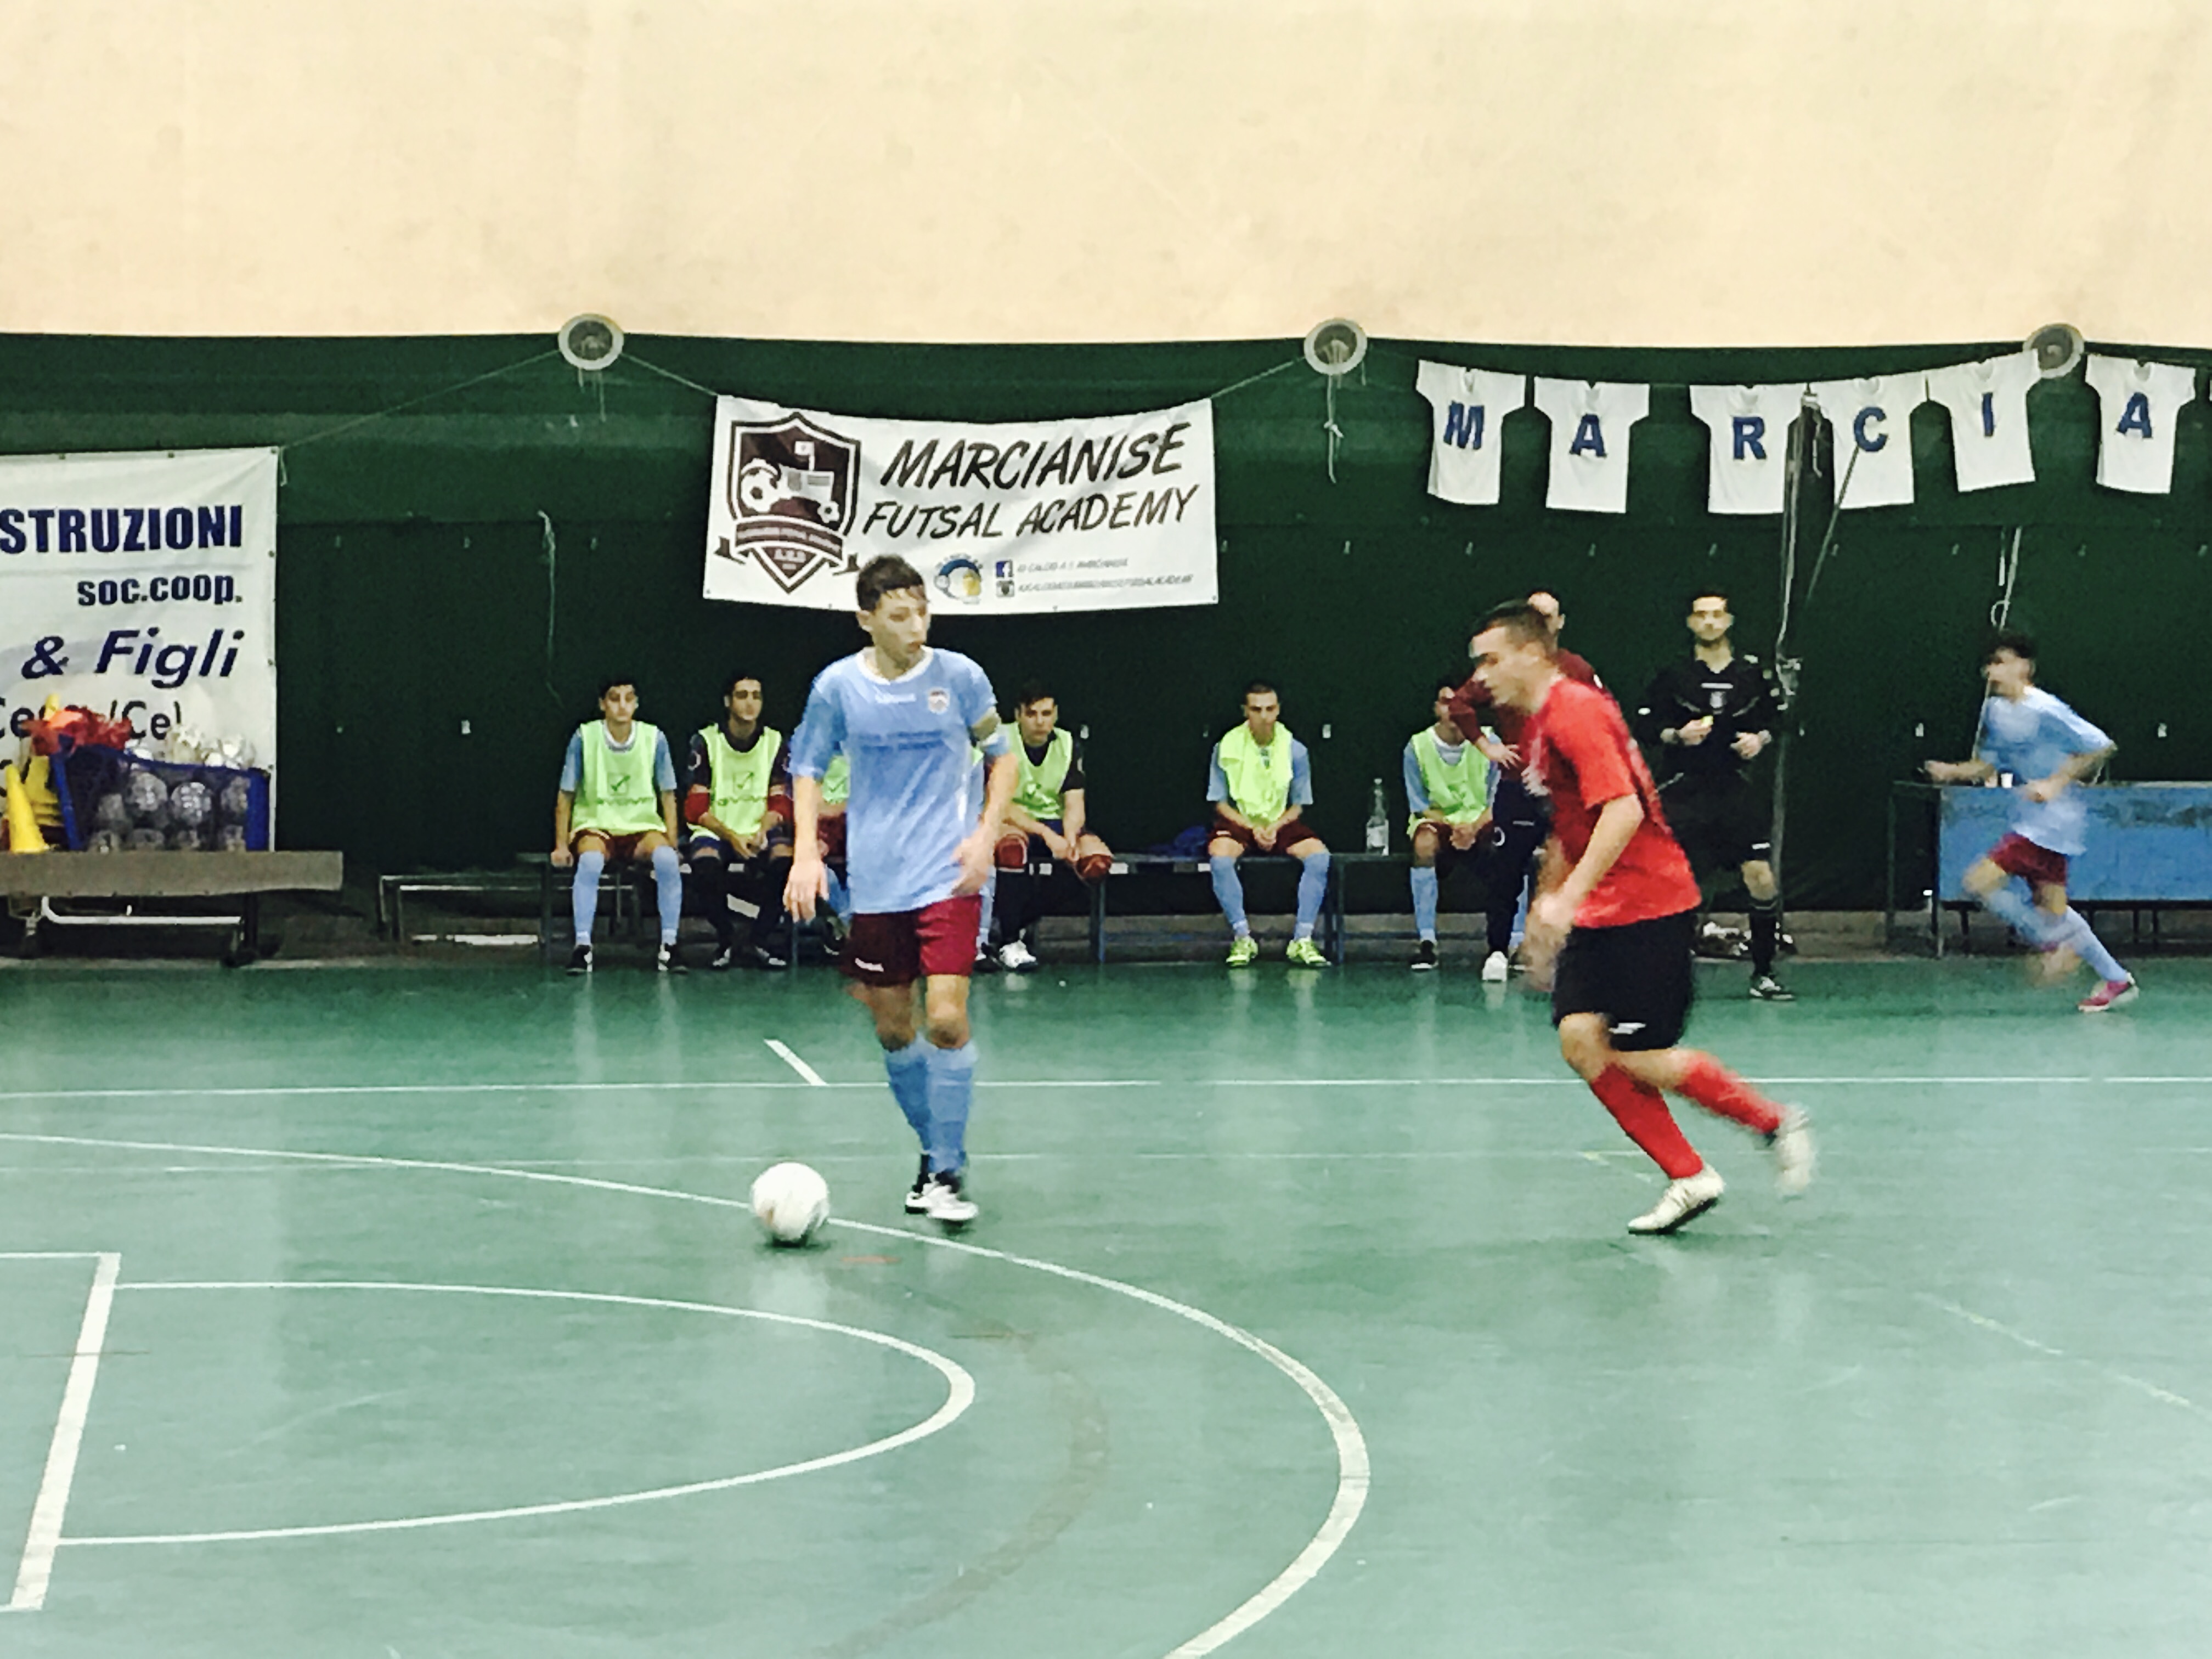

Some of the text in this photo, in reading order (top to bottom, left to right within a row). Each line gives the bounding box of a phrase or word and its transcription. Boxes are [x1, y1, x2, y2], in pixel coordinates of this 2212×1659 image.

[879, 421, 1192, 489] MARCIANISE
[0, 505, 243, 554] STRUZIONI
[862, 484, 1200, 540] FUTSAL ACADEMY
[77, 574, 242, 606] soc.coop.
[21, 627, 245, 689] & Figli
